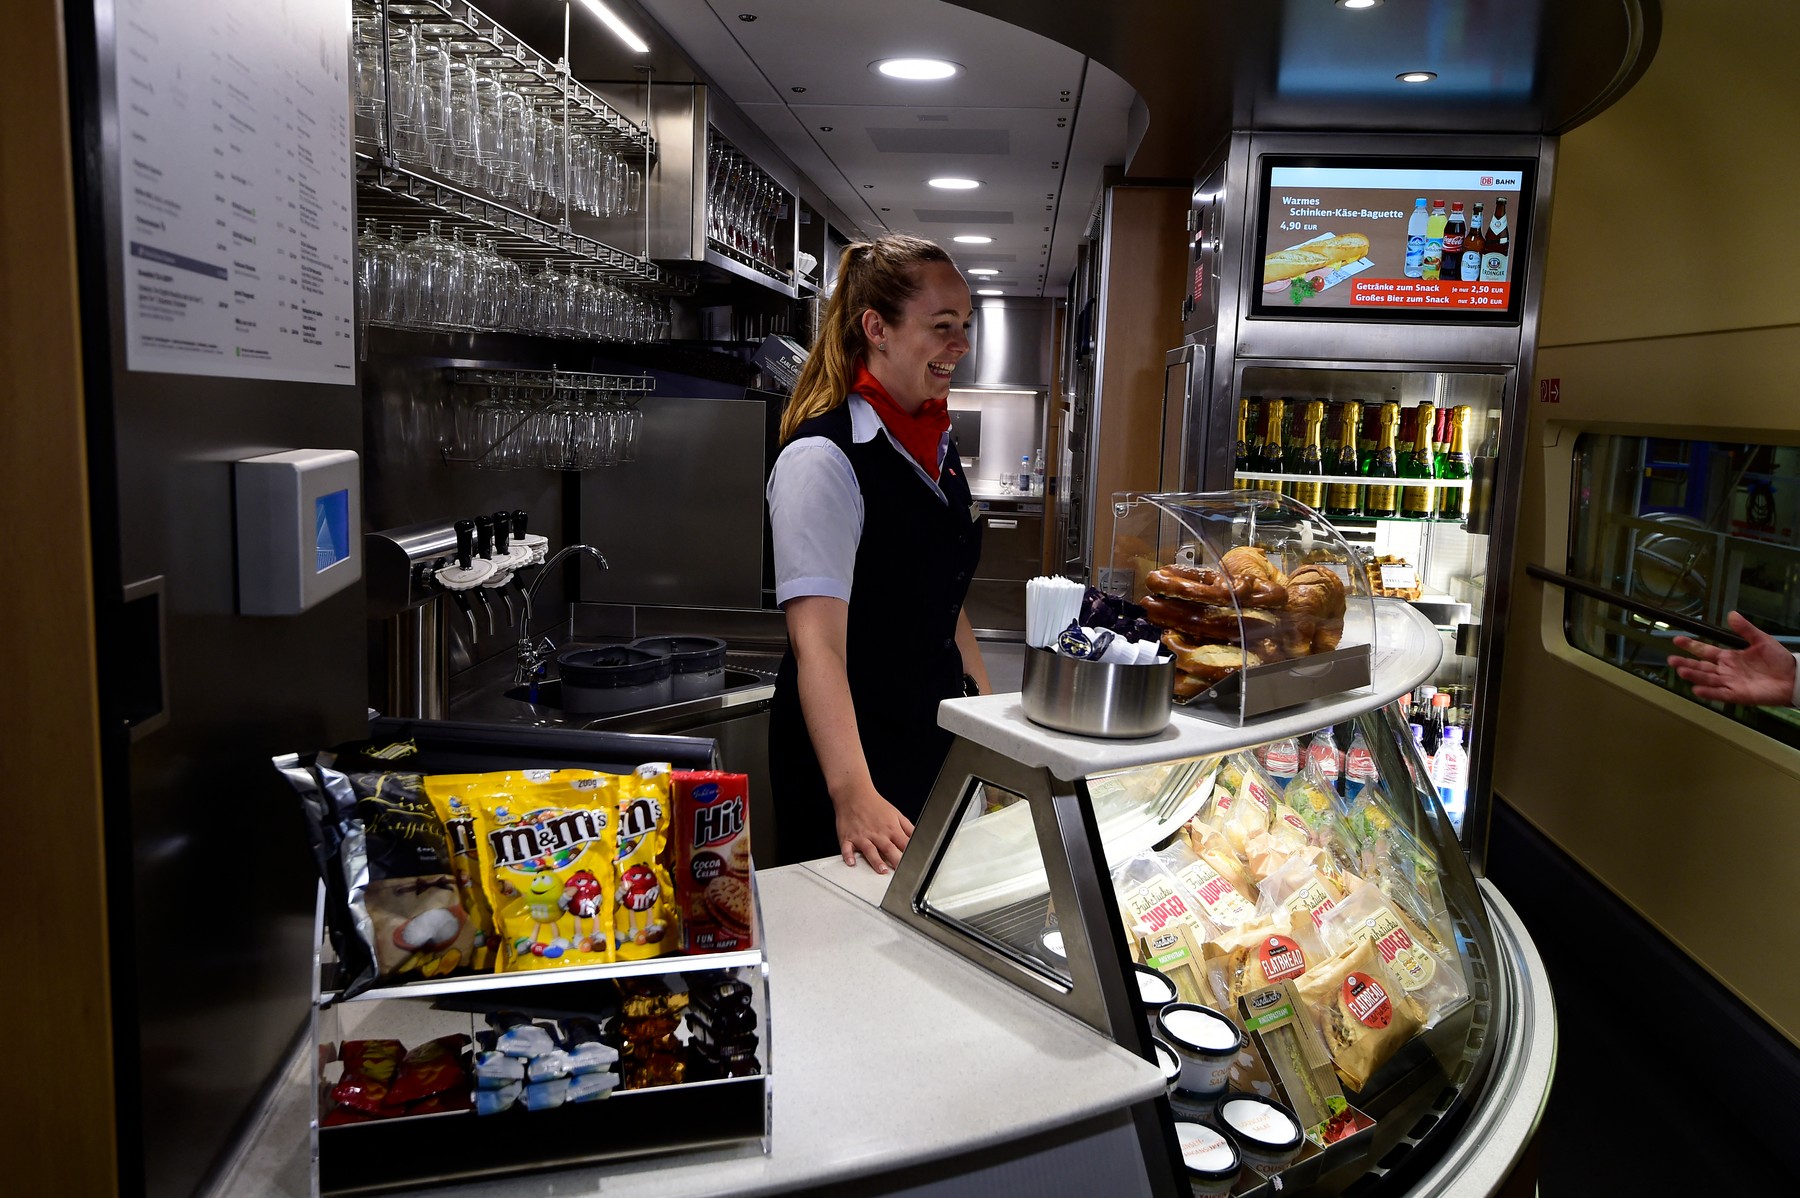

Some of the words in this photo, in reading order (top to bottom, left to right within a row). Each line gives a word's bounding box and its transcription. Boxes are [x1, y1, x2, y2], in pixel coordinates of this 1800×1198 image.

[1481, 177, 1493, 186] DB
[1282, 196, 1320, 206] Warmes
[1290, 208, 1404, 219] Schinken-Käse-Baguette
[1280, 221, 1301, 231] 4,90
[1356, 282, 1394, 291] Getränke
[1415, 284, 1440, 292] Snack
[1471, 285, 1489, 294] 2,50
[1355, 294, 1385, 302] Großes
[1387, 294, 1404, 302] Bier
[1425, 295, 1450, 304] Snack
[1469, 296, 1488, 305] 3,00
[578, 778, 597, 788] 200g
[694, 797, 744, 849] Hit
[693, 860, 721, 872] COCOA
[696, 870, 720, 879] CREME
[716, 940, 737, 949] HAPPY
[1261, 949, 1304, 977] FLATBREAD
[1348, 982, 1386, 1018] FLATBREAD
